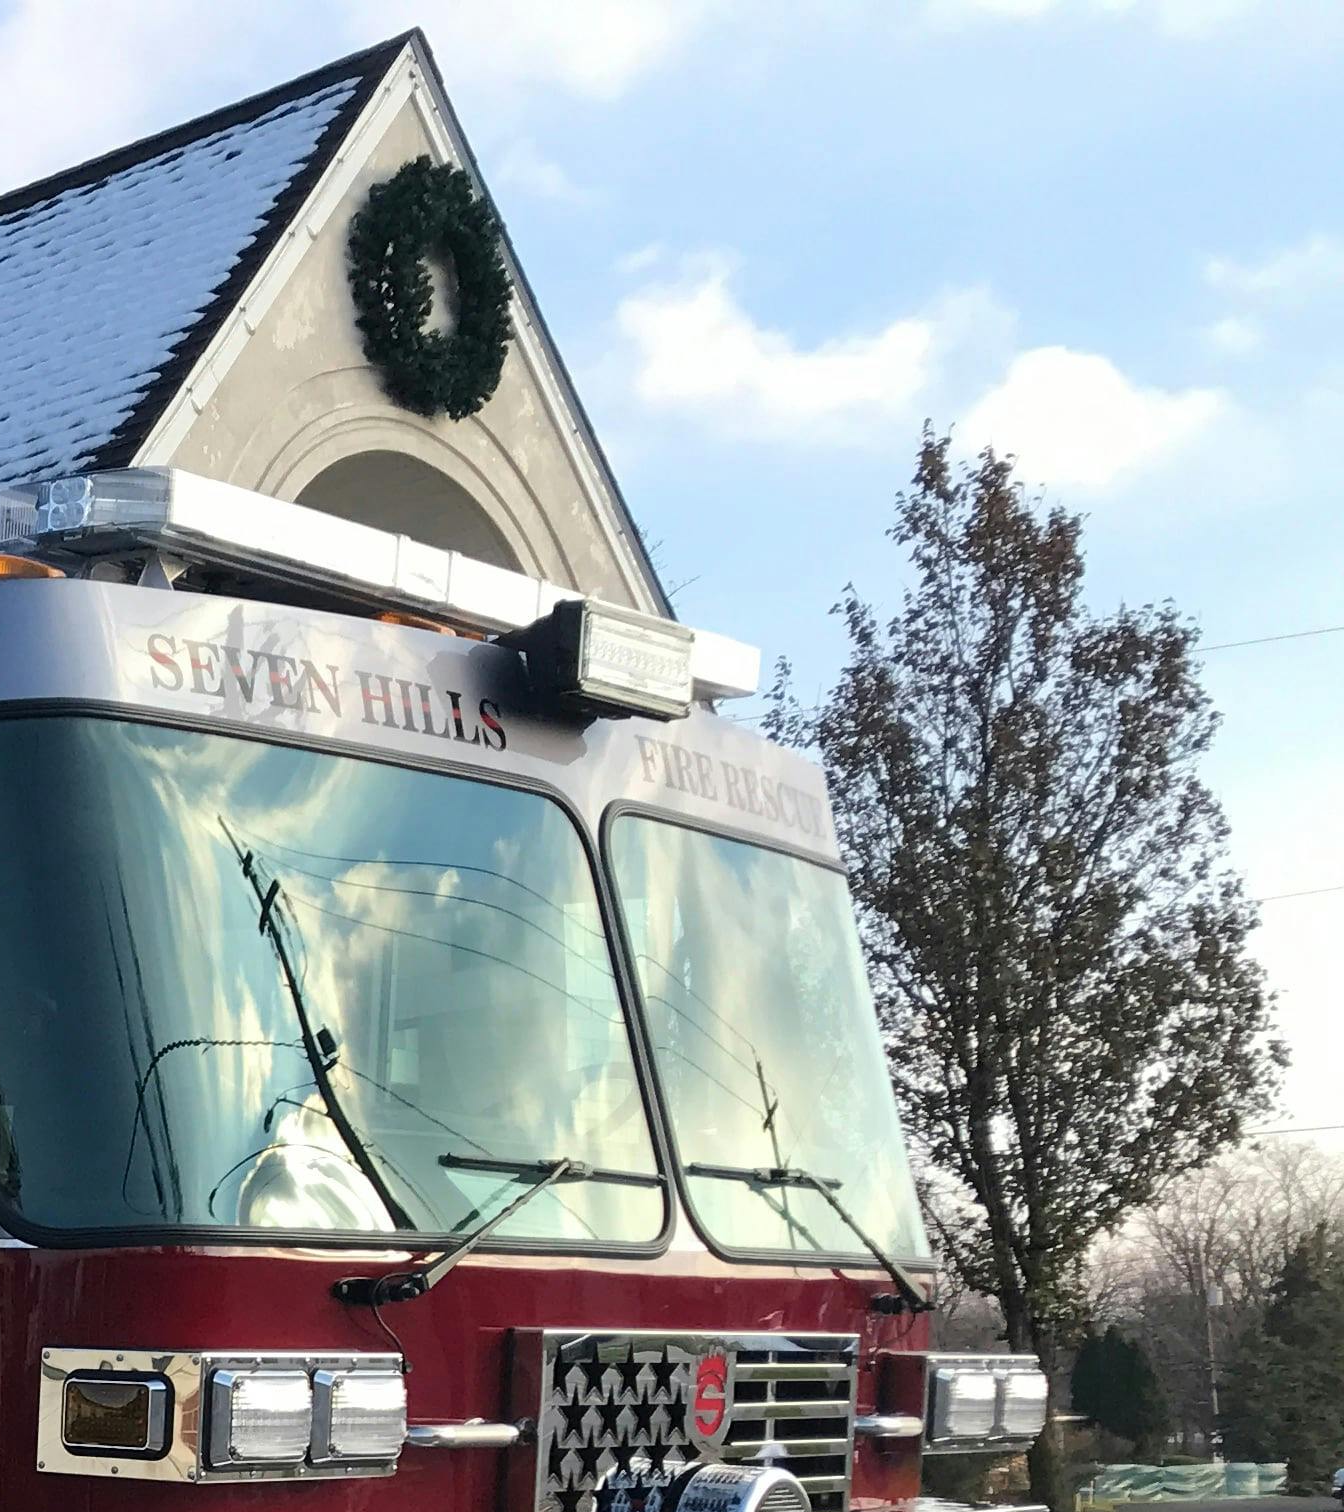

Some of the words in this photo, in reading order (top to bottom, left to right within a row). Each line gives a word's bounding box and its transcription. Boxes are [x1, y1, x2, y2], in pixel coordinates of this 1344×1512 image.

[146, 632, 342, 718] SEVEN
[354, 669, 507, 752] HILLS
[633, 734, 718, 802] FIRE
[720, 760, 828, 840] RESCUE
